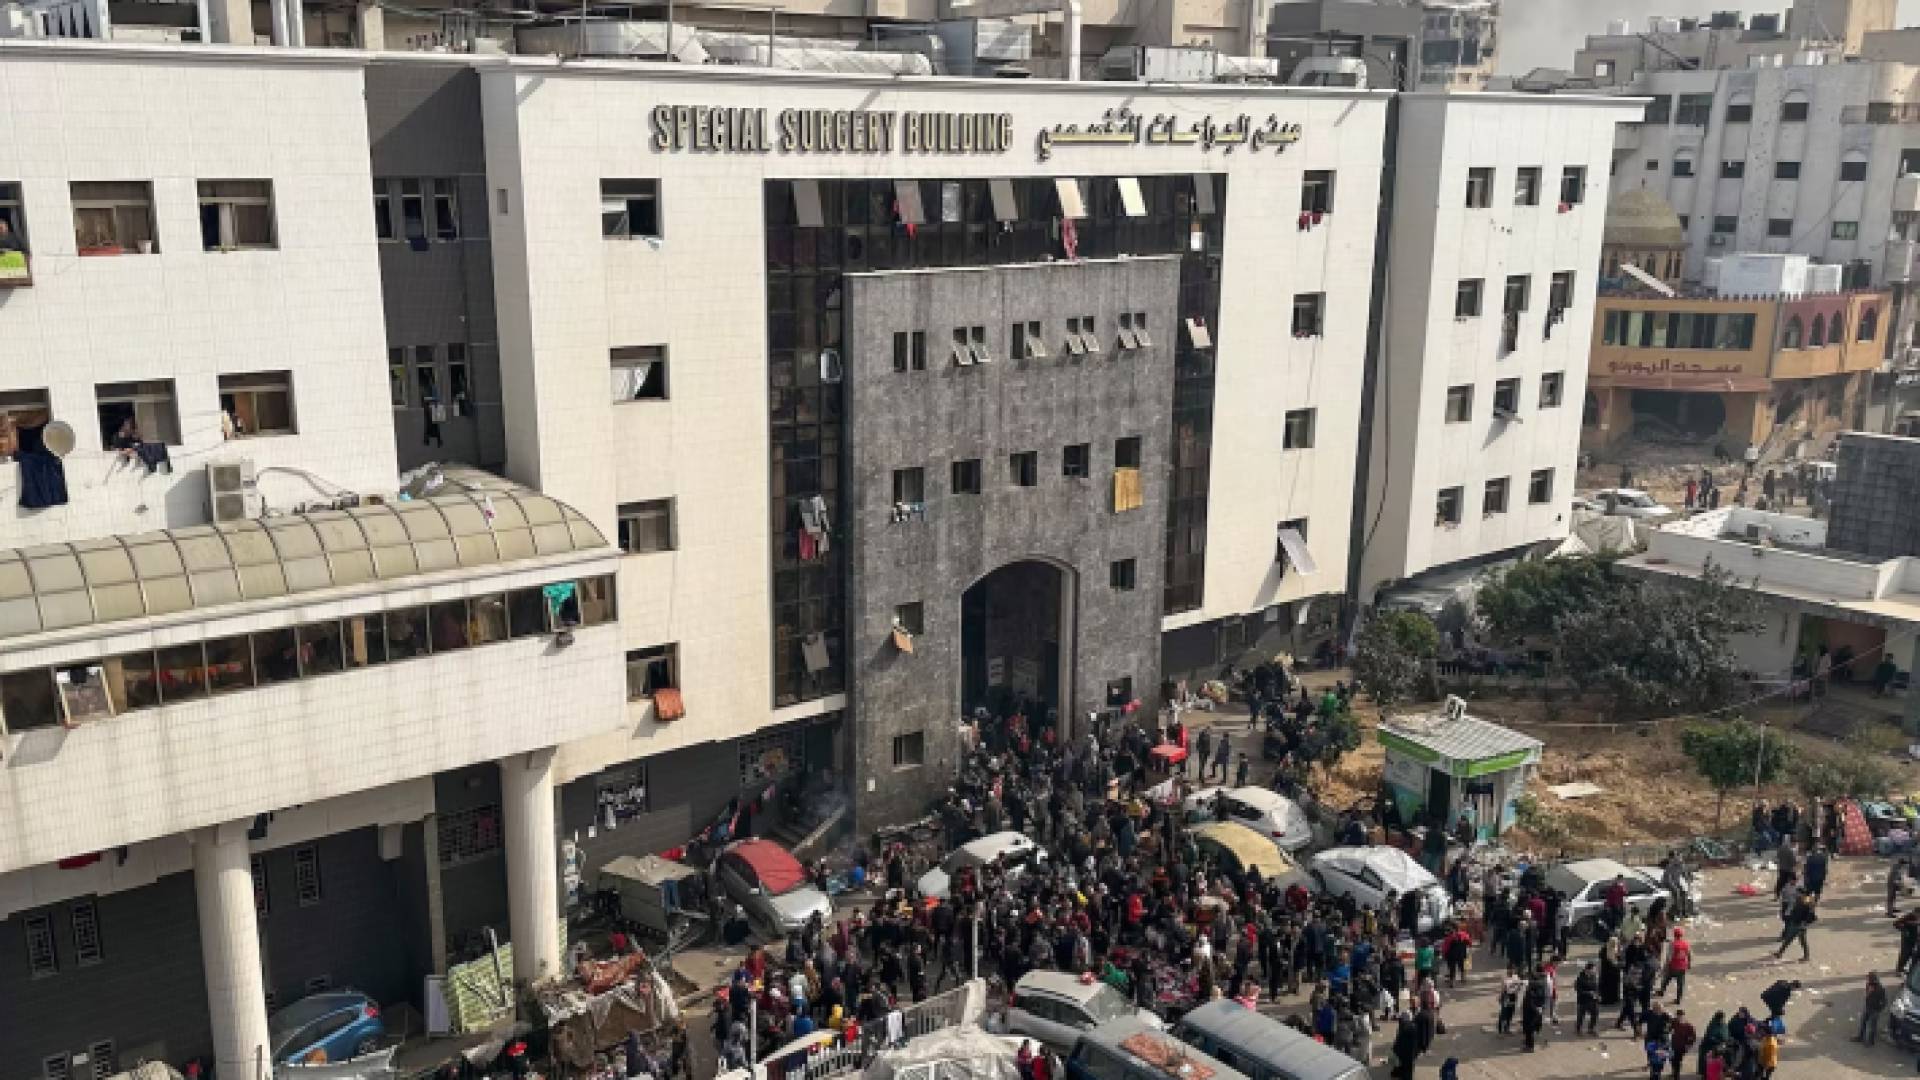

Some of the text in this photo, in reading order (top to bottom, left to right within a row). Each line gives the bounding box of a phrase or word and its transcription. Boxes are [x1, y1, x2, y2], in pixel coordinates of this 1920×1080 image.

[651, 105, 1013, 155] SPECIAL SURGERY BUILDING
[1671, 361, 1742, 375] مسجد
